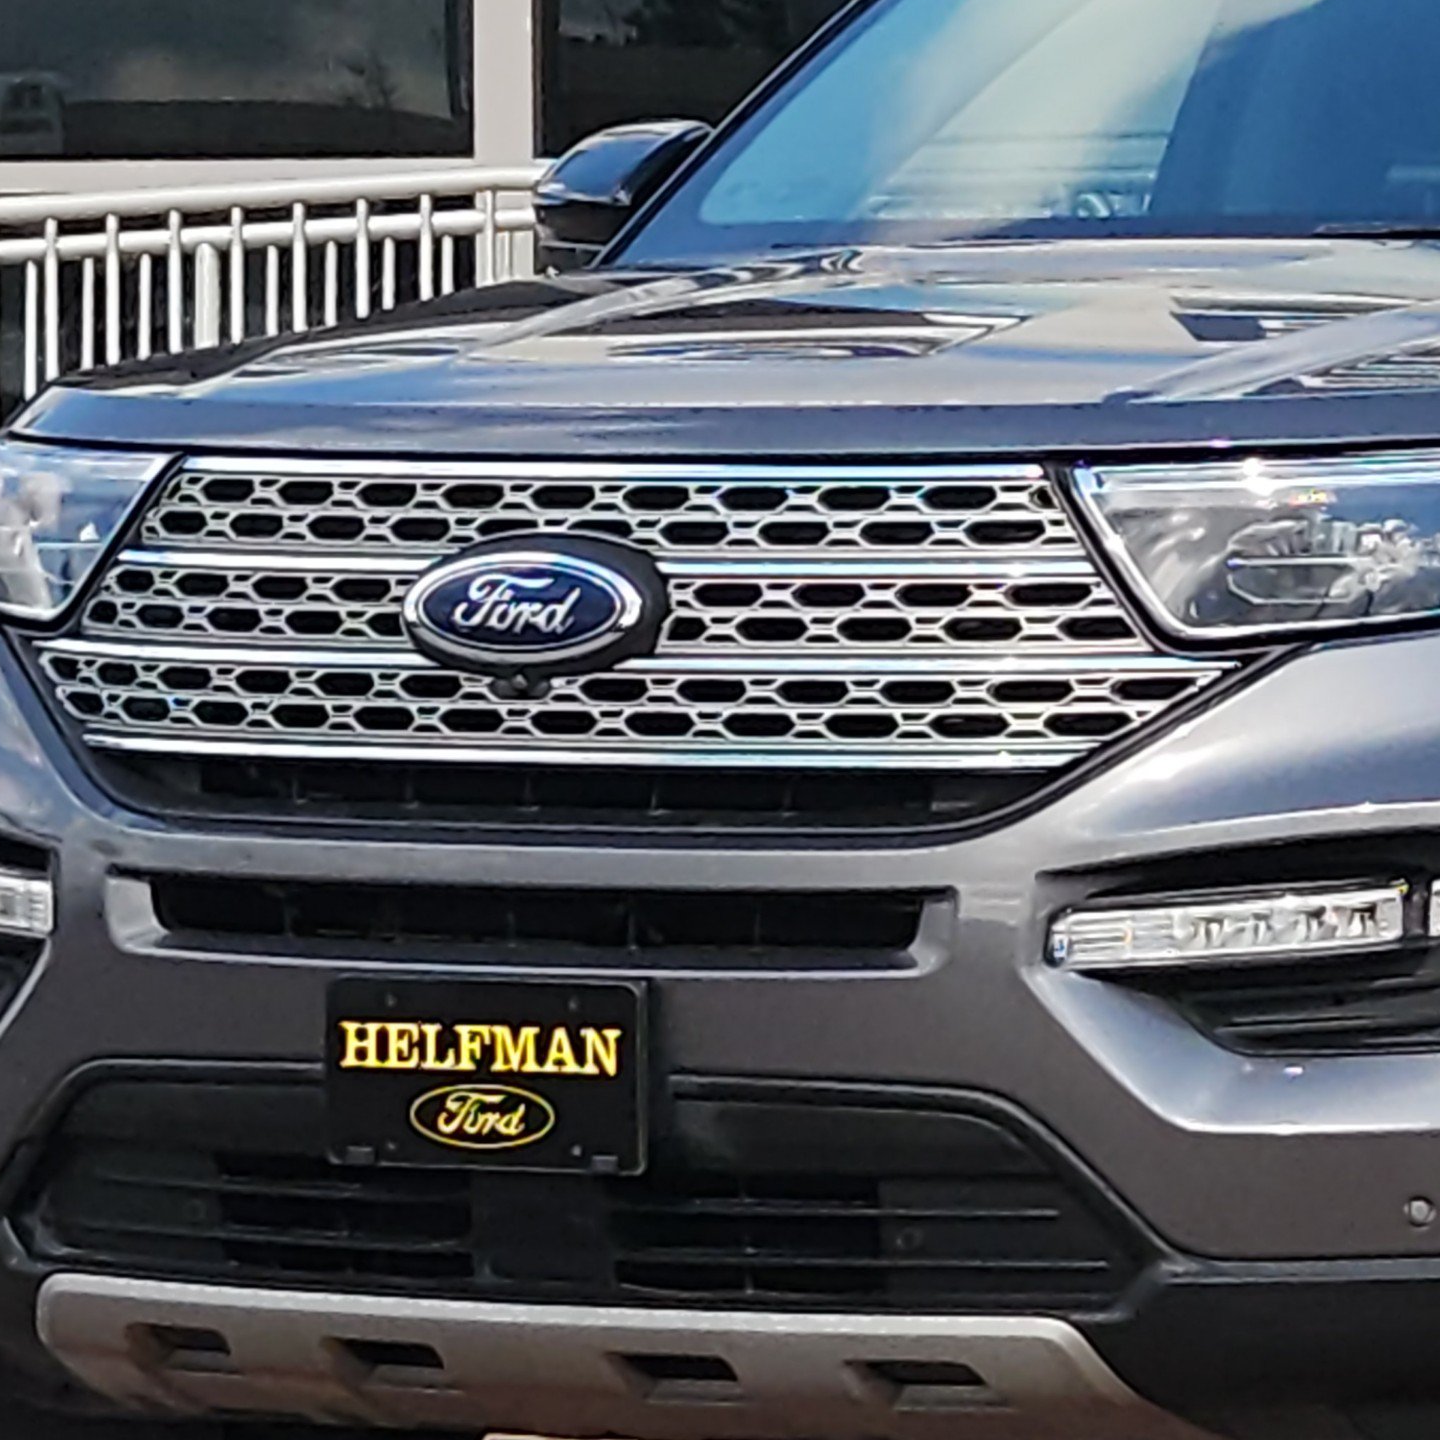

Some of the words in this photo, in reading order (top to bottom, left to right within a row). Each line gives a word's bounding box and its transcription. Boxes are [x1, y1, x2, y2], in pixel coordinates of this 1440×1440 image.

[452, 570, 580, 636] Ford
[338, 1019, 622, 1078] HELFMAN
[437, 1090, 526, 1138] Ford
